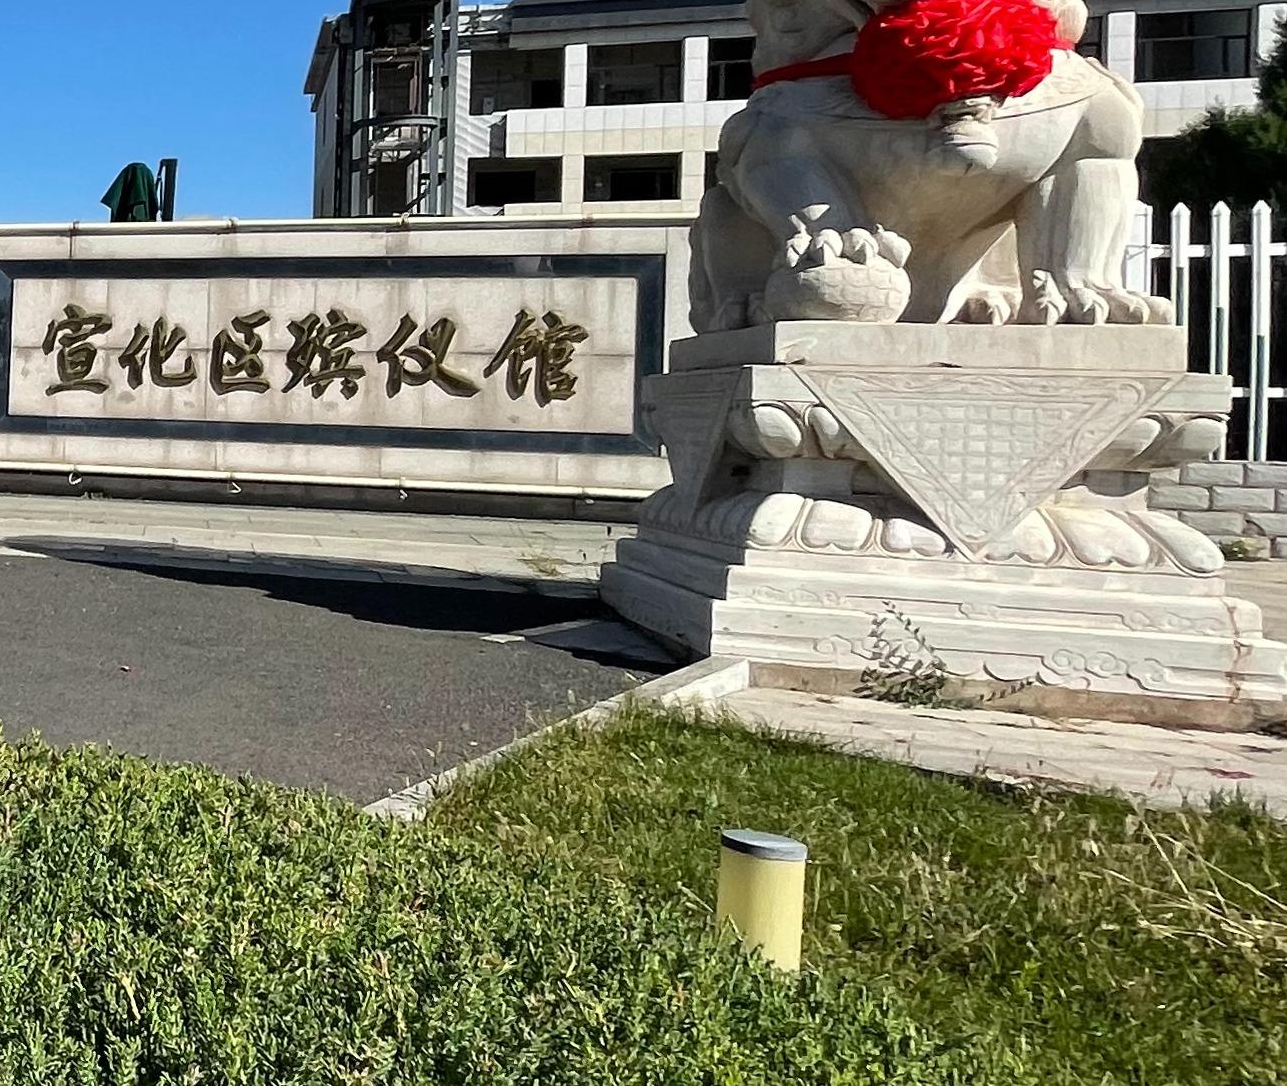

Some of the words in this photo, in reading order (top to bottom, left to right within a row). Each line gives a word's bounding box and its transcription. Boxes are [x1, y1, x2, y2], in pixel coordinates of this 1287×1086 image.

[40, 303, 589, 408] 宣化区殡仪馆
